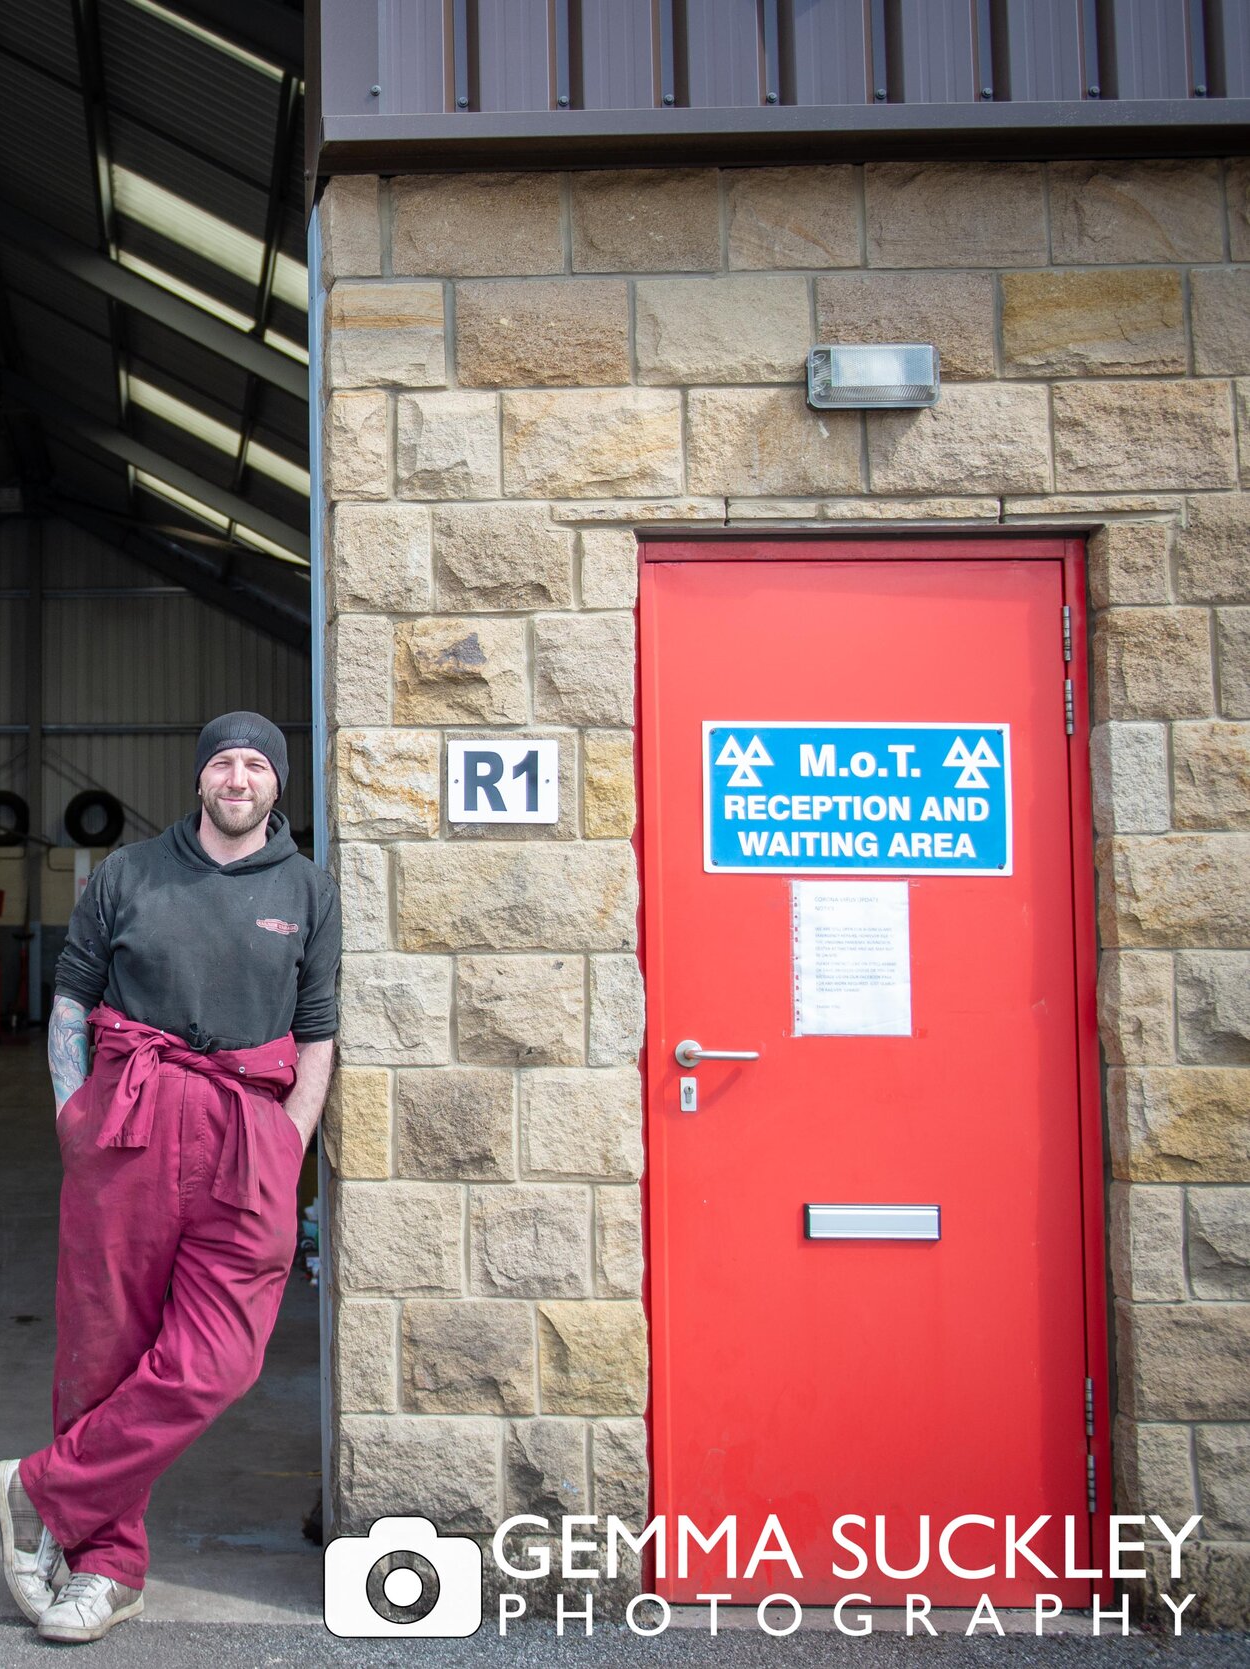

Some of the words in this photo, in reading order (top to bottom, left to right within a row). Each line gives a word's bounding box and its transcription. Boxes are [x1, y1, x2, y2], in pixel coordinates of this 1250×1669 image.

[799, 744, 921, 778] M.o.T.
[463, 750, 538, 812] R1
[724, 795, 911, 821] RECEPTION
[920, 796, 990, 822] AND
[737, 831, 878, 858] WAITING
[887, 832, 977, 858] AREA
